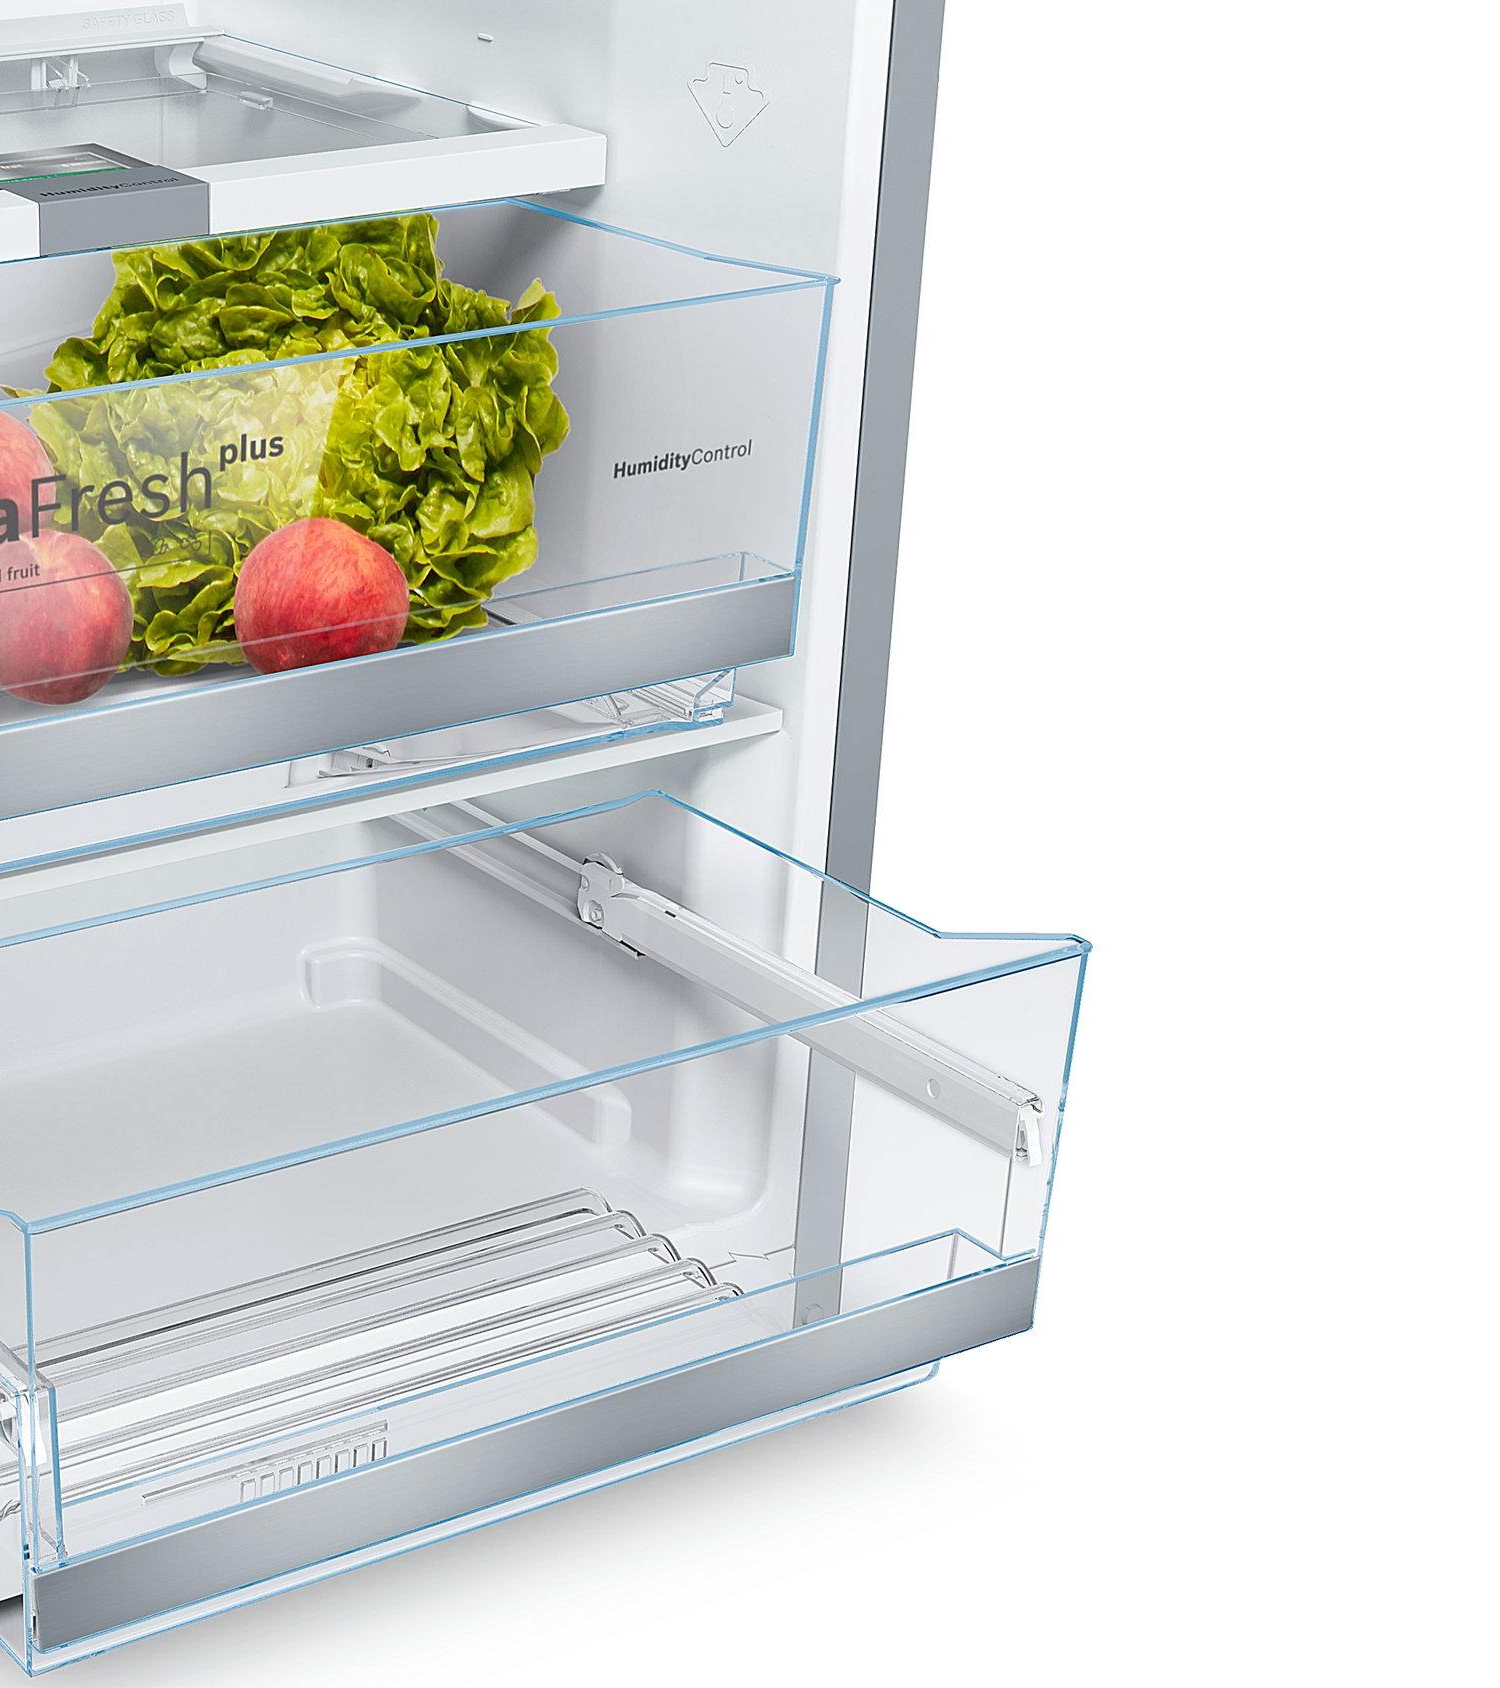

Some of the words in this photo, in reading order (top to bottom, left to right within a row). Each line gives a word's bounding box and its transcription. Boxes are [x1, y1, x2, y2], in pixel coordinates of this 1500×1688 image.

[133, 10, 175, 25] GLASS
[219, 433, 285, 471] plus
[613, 438, 753, 480] HumidityControl
[7, 563, 40, 581] fruit
